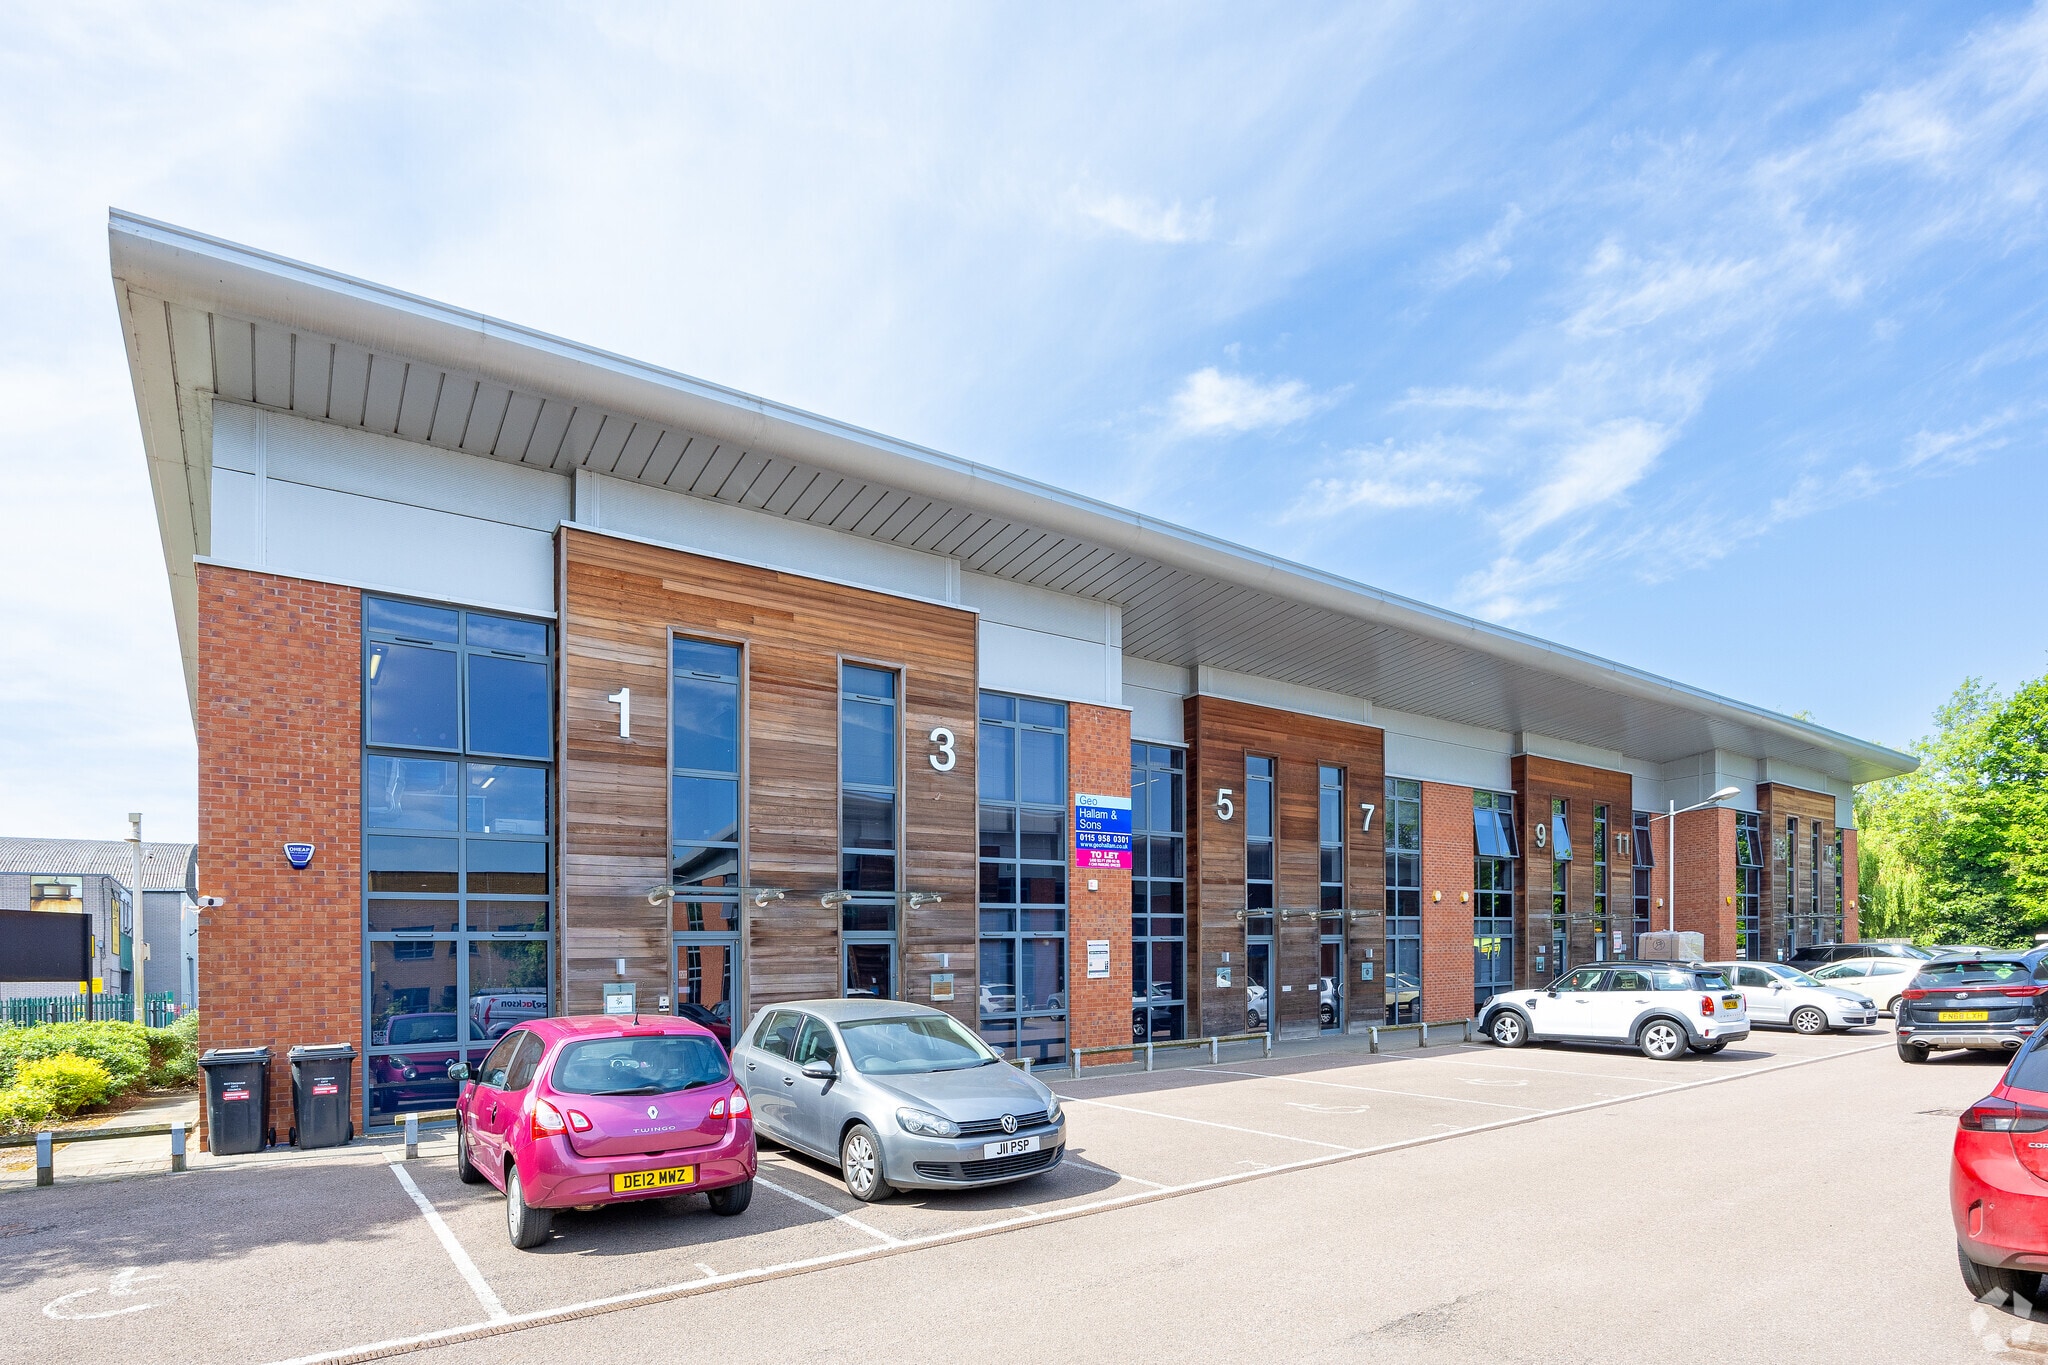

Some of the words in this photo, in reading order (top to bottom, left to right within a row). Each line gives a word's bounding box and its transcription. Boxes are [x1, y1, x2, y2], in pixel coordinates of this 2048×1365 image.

[608, 687, 630, 739] 1
[929, 727, 957, 772] 3
[1080, 795, 1097, 805] Geo
[1216, 788, 1234, 821] 5
[1079, 807, 1108, 820] Hallam
[1110, 810, 1117, 820] &
[1361, 803, 1375, 832] 7
[1080, 819, 1101, 829] Sons
[1080, 833, 1096, 842] 0115
[1097, 834, 1111, 842] 958
[1113, 835, 1129, 844] 0301
[1535, 823, 1546, 848] 9
[1080, 842, 1128, 850] www.geohallam.co.uk
[1616, 832, 1629, 855] 11
[1090, 850, 1102, 859] TO
[1104, 851, 1119, 860] LET
[633, 1125, 676, 1134] TWINGO
[1010, 1139, 1030, 1153] PSP
[623, 1172, 655, 1189] DE12
[659, 1169, 686, 1185] MWZ
